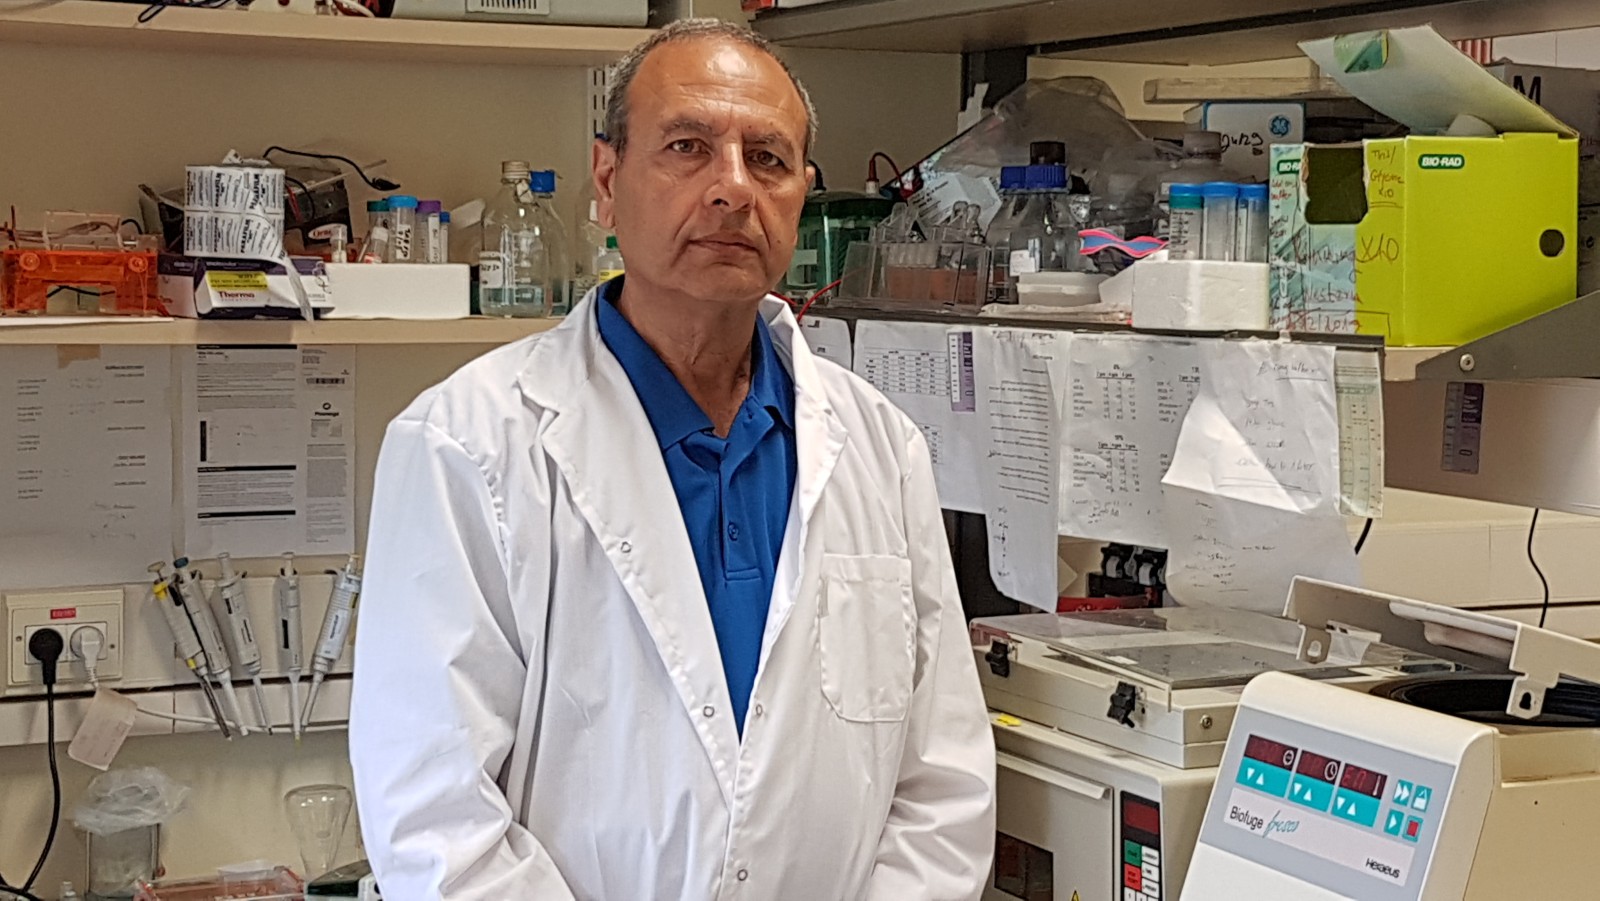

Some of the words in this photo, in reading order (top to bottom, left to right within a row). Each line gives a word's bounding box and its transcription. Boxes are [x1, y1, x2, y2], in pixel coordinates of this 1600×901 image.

[1421, 156, 1463, 168] BIO-RAD
[1229, 805, 1264, 831] Biofuge
[1366, 857, 1400, 879] Heraeus
